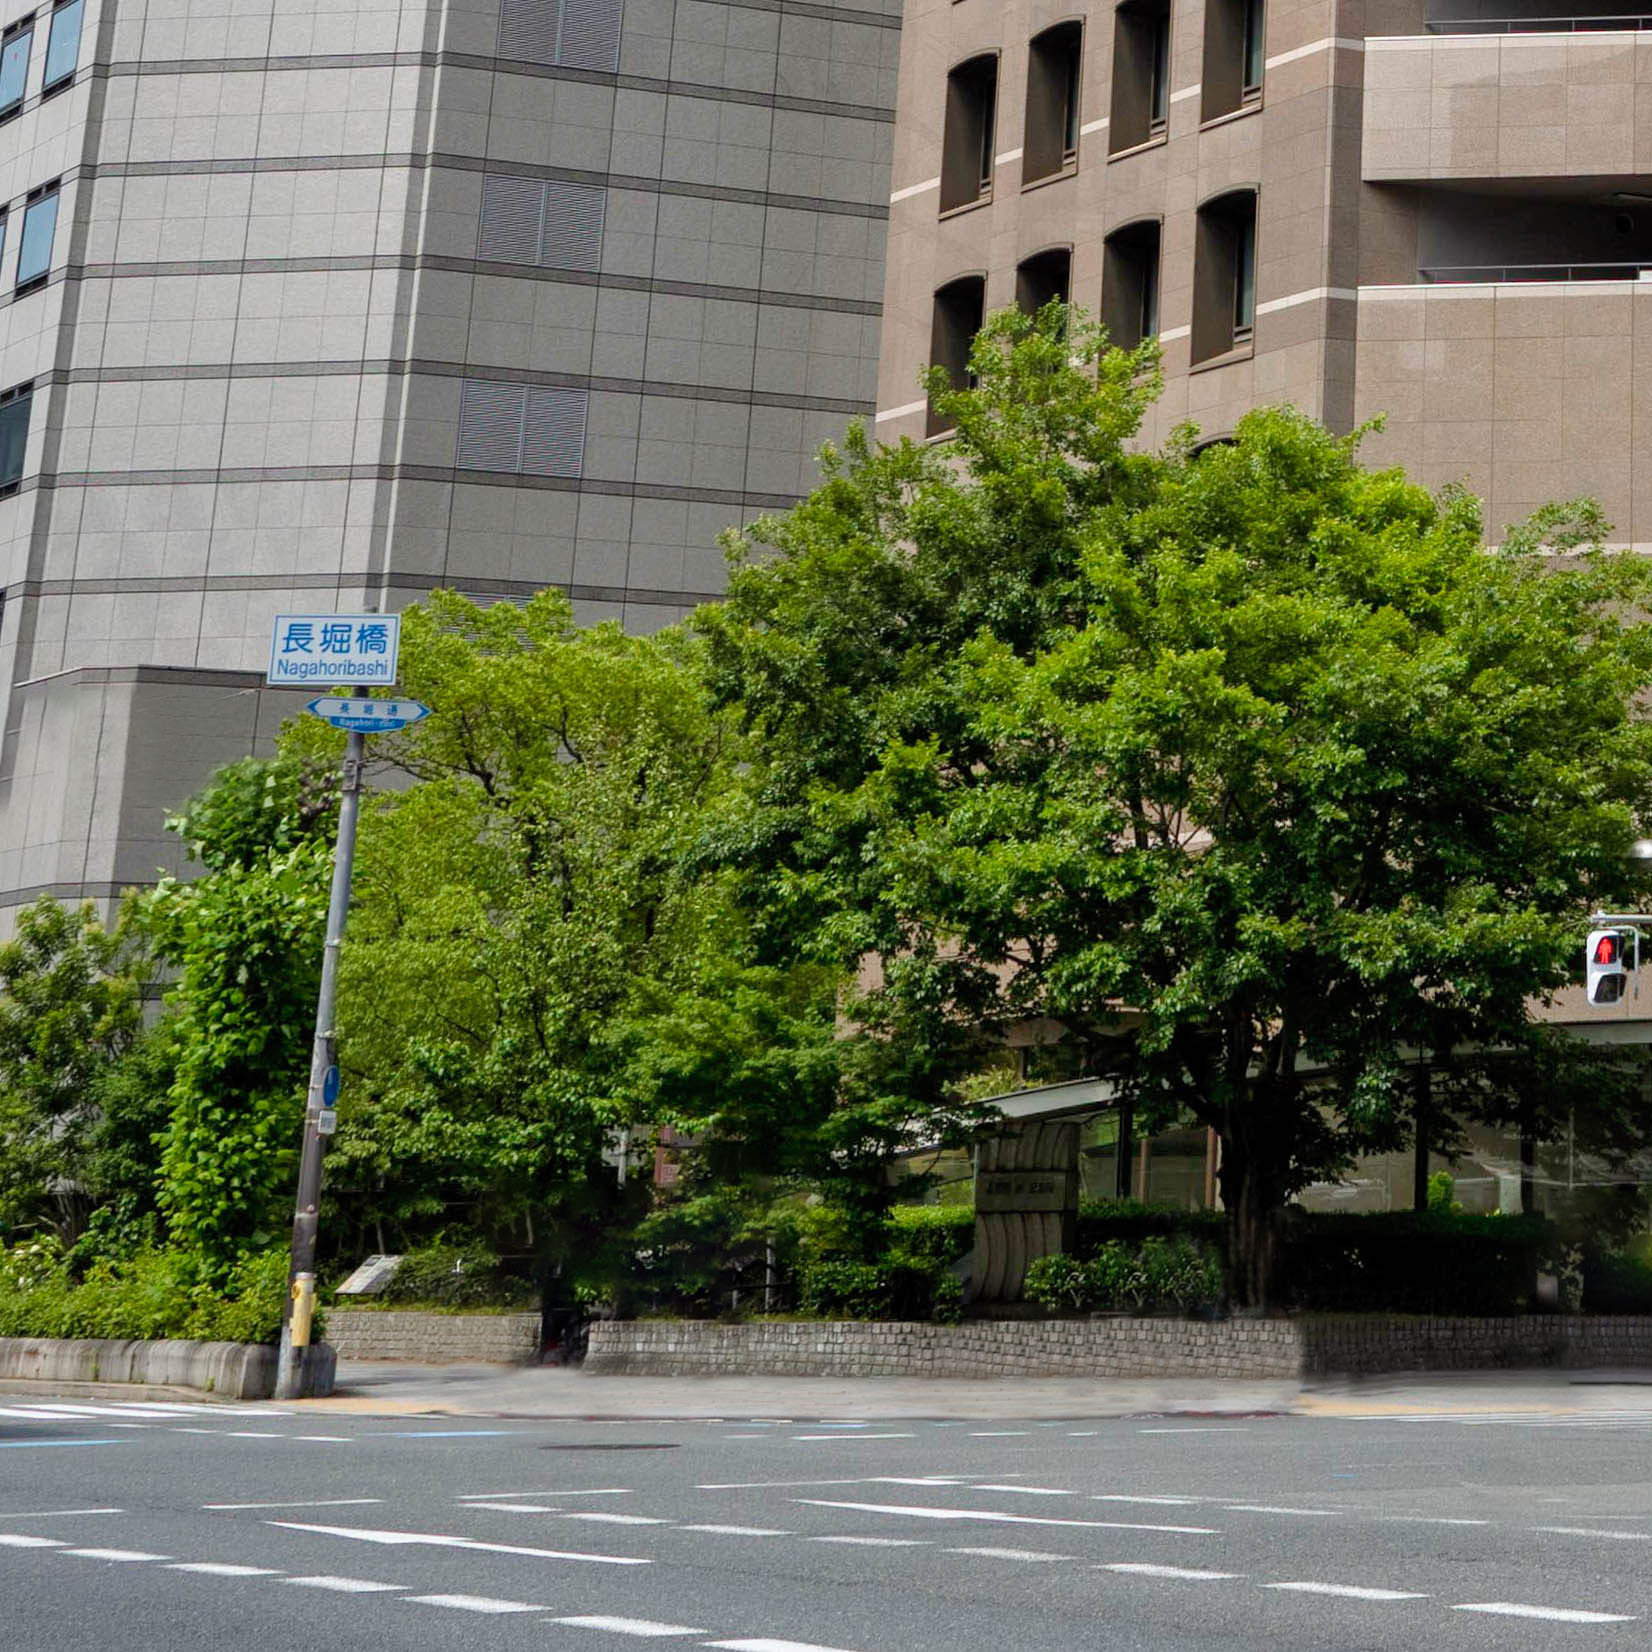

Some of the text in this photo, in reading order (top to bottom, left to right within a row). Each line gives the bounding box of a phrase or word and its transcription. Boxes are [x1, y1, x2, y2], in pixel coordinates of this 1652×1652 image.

[281, 623, 389, 655] 長堀橋
[277, 658, 389, 679] Nagahoribashi
